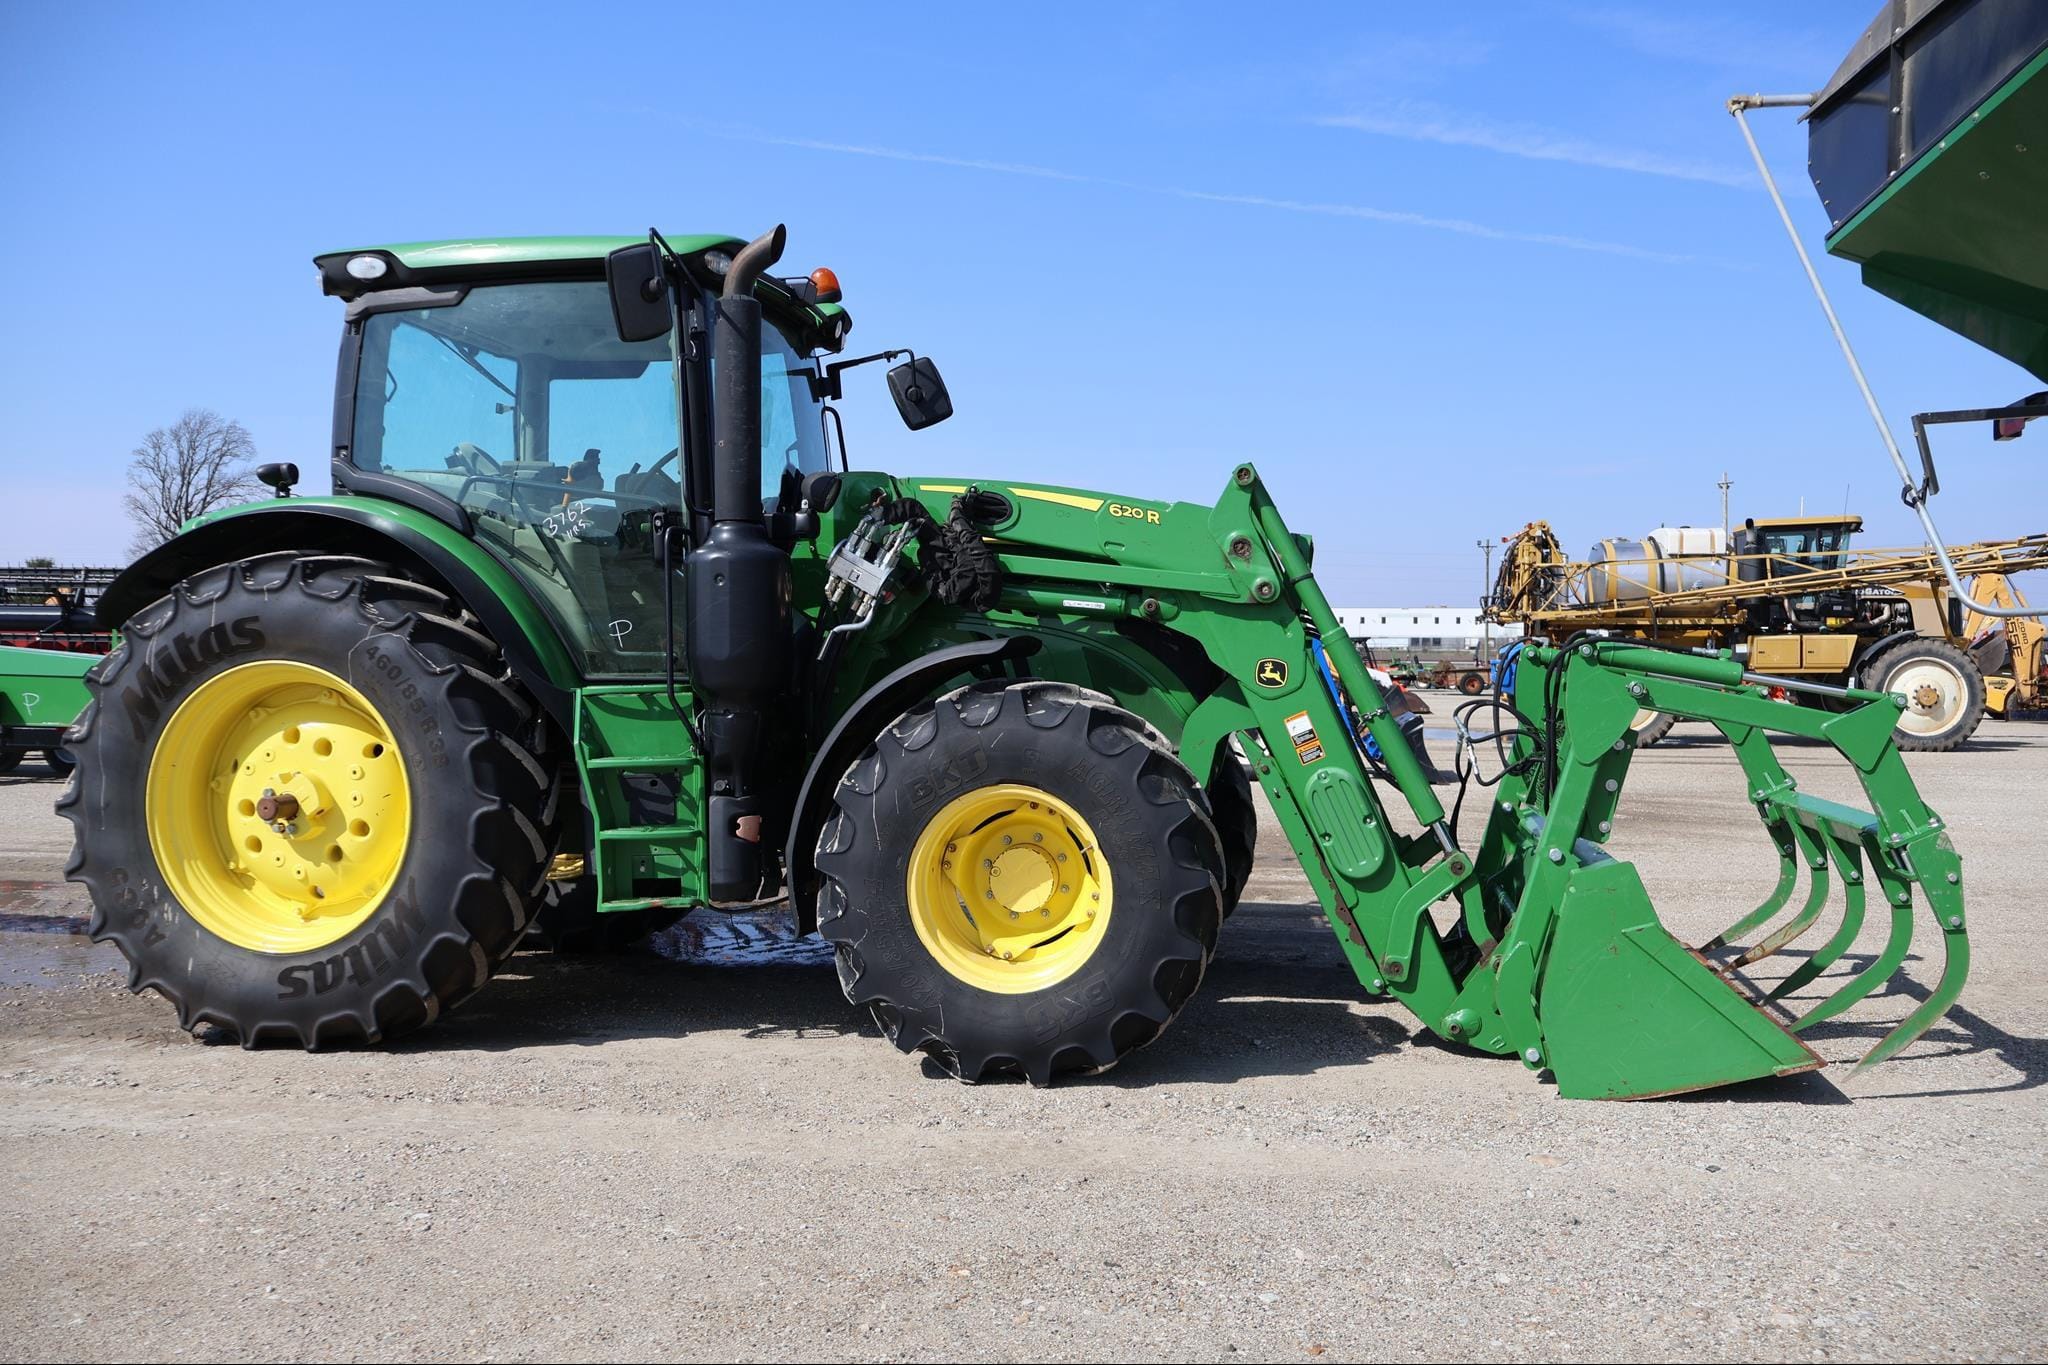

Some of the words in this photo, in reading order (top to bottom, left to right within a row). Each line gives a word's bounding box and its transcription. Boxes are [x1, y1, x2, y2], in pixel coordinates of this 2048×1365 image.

[543, 500, 592, 536] 3762
[1108, 503, 1144, 519] 620
[1147, 509, 1161, 525] R
[608, 619, 633, 648] P
[2019, 621, 2029, 645] FORD
[120, 615, 267, 744] Mitas
[22, 692, 40, 716] P
[277, 875, 427, 1000] Mitas
